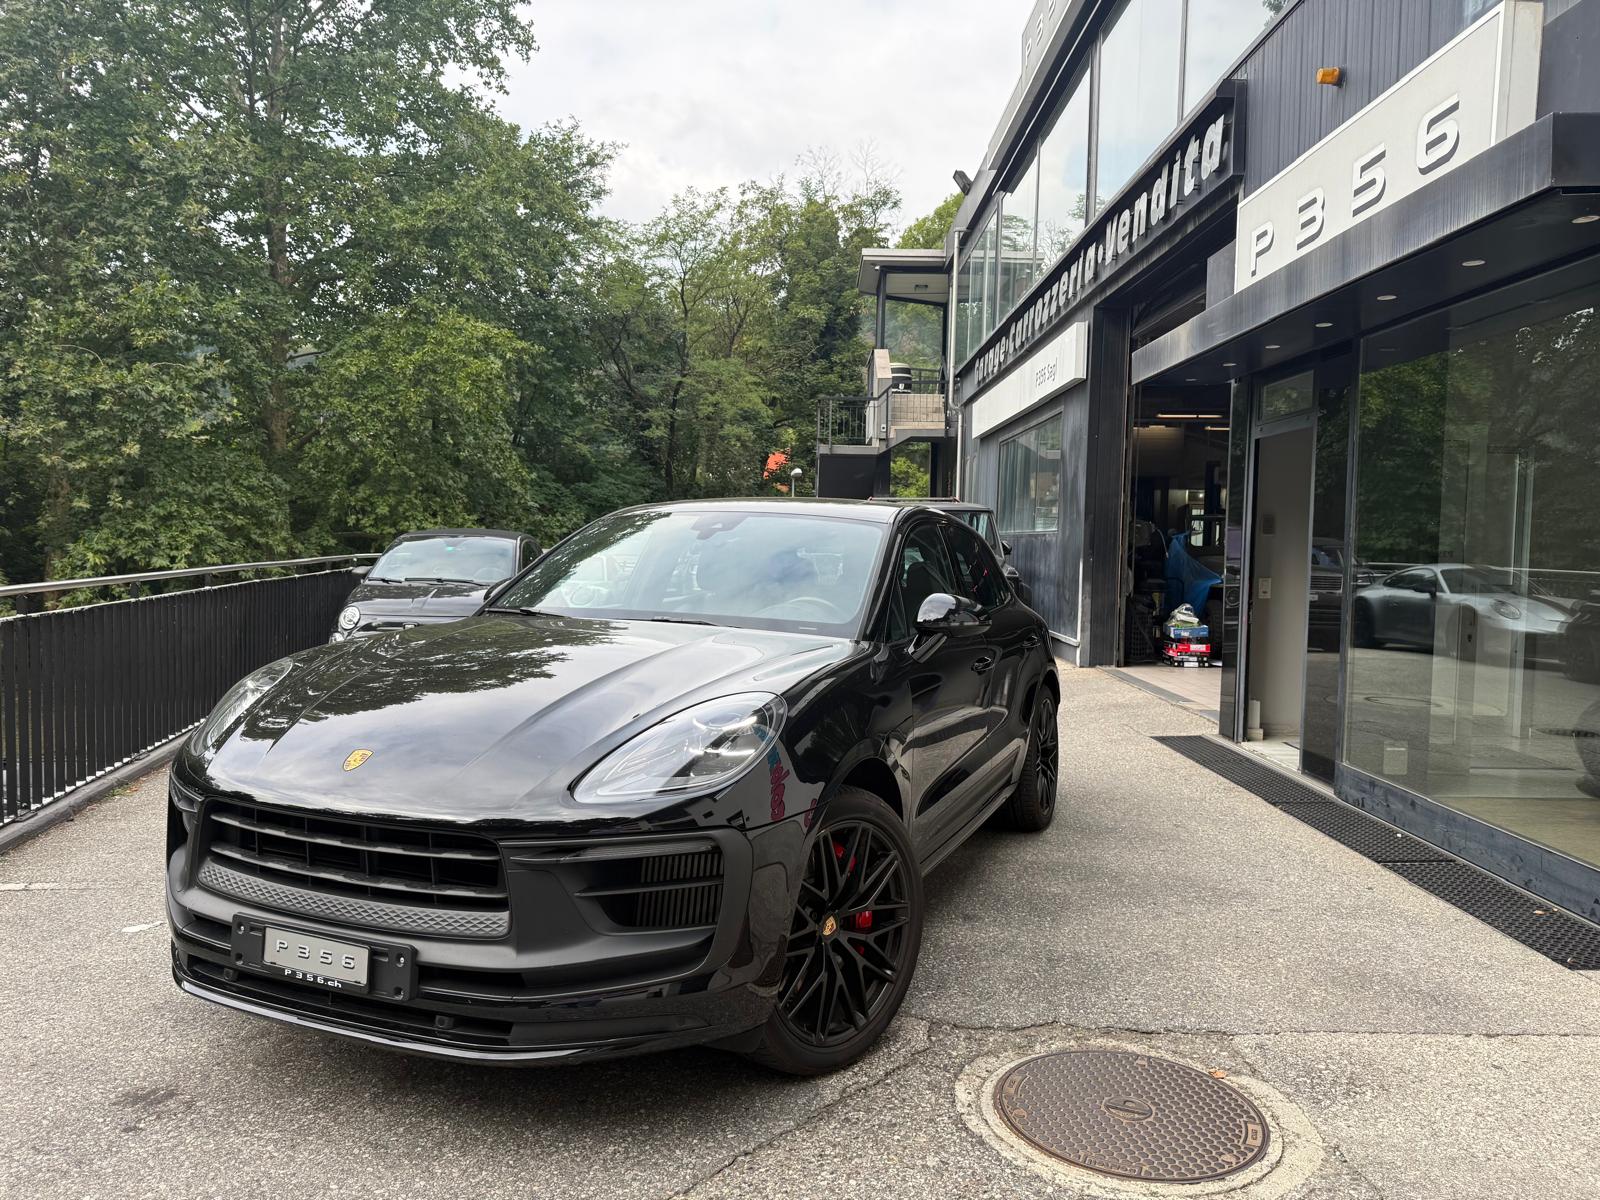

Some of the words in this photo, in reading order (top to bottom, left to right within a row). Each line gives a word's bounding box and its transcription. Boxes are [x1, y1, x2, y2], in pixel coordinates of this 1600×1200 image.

[1250, 93, 1460, 278] P356
[276, 939, 357, 969] P356
[284, 968, 342, 988] P356.ch
